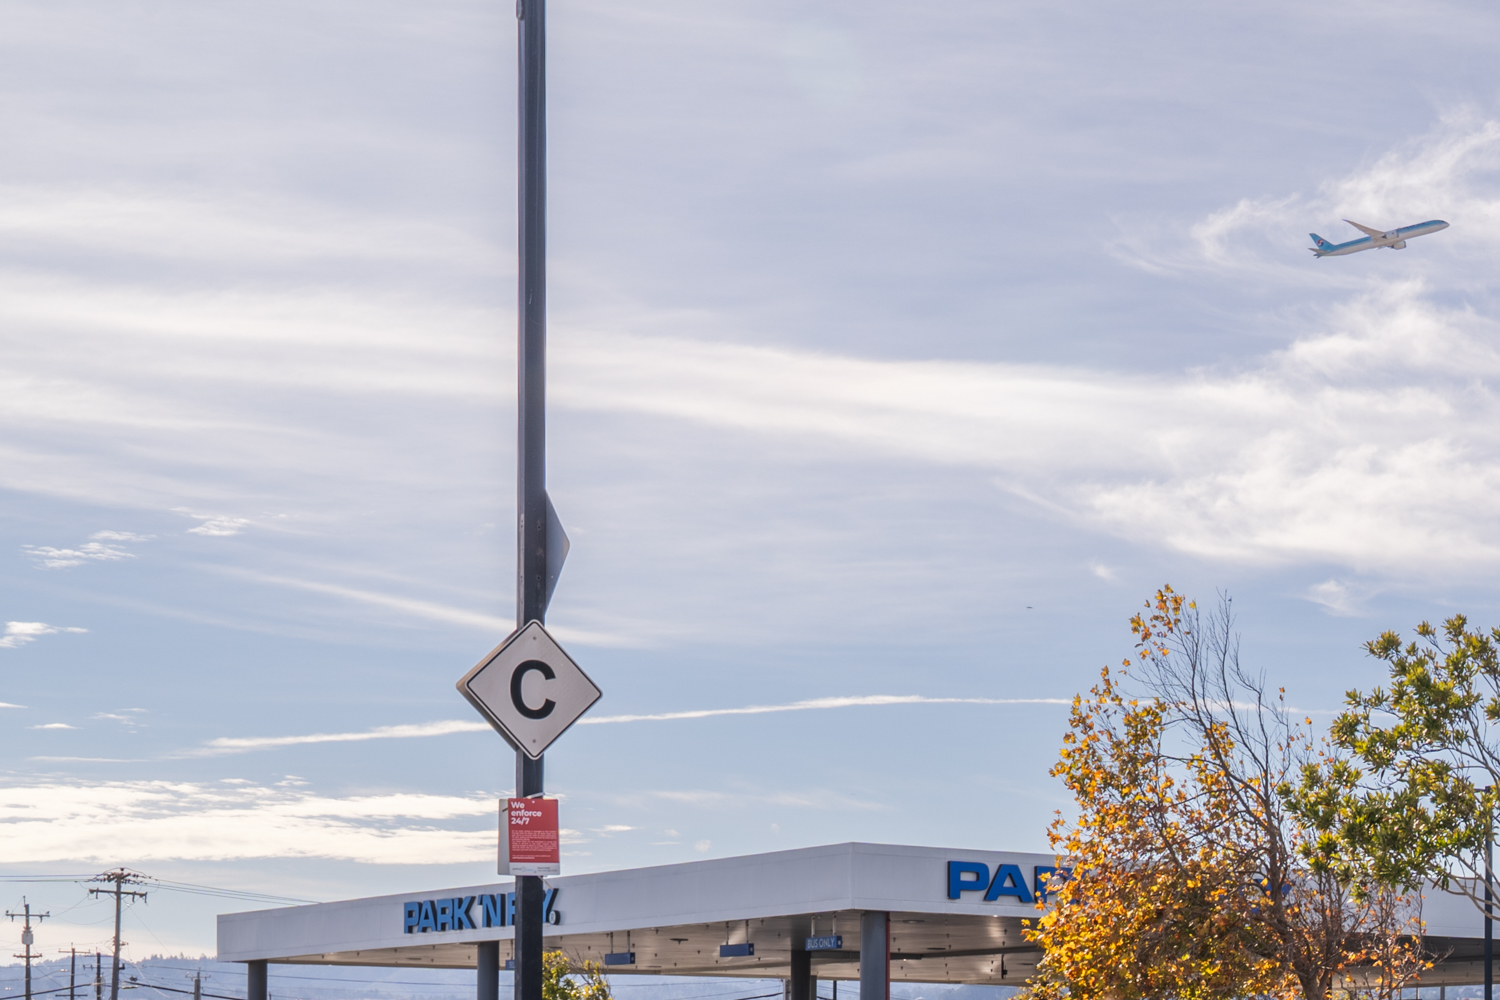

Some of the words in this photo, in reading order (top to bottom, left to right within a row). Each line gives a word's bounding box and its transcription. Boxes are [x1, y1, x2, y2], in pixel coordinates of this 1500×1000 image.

[510, 659, 556, 719] C
[511, 801, 525, 809] We
[511, 809, 542, 817] enforce
[511, 817, 530, 825] 24/7
[404, 896, 477, 934] PARK
[807, 939, 818, 948] BUS
[818, 938, 835, 948] ONLY
